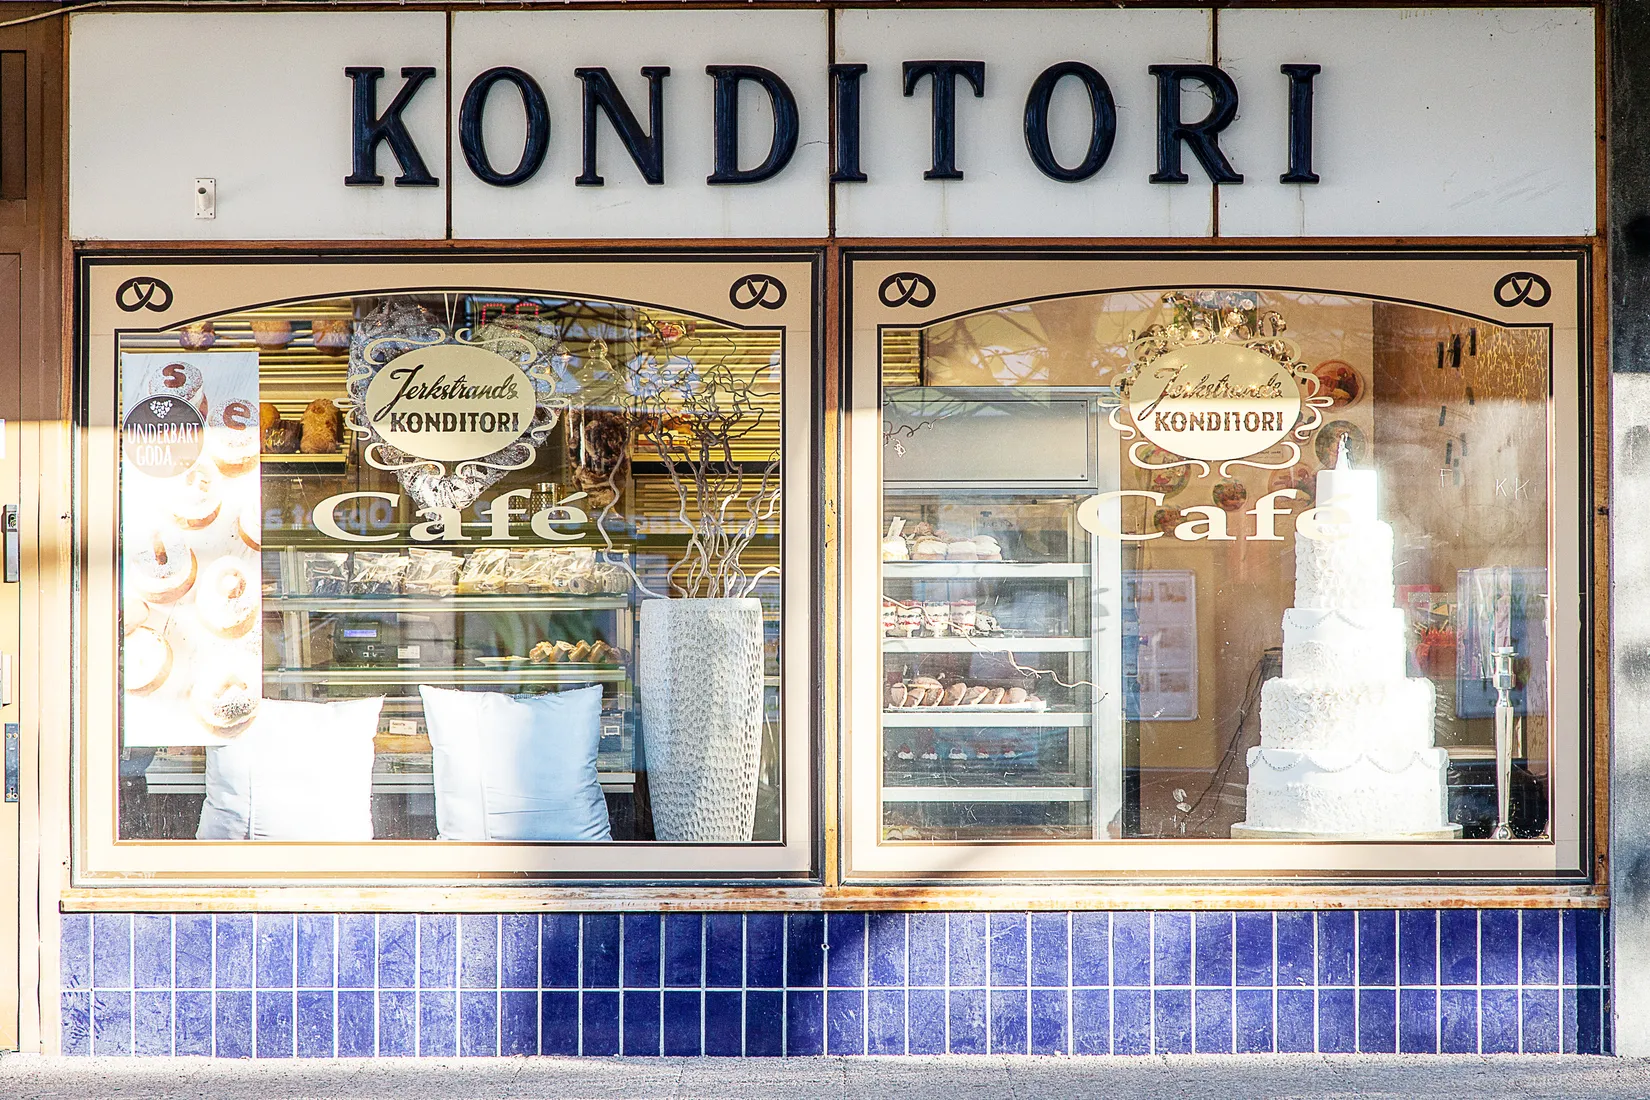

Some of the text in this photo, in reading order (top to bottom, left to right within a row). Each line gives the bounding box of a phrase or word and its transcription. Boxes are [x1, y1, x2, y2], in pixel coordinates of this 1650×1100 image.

[345, 60, 1320, 187] KONDITORI
[373, 364, 519, 422] Jerkstrands
[127, 422, 199, 444] UNDERBART
[390, 412, 519, 433] KONDITORI
[1154, 411, 1283, 432] KONDITORI
[312, 489, 589, 542] Café
